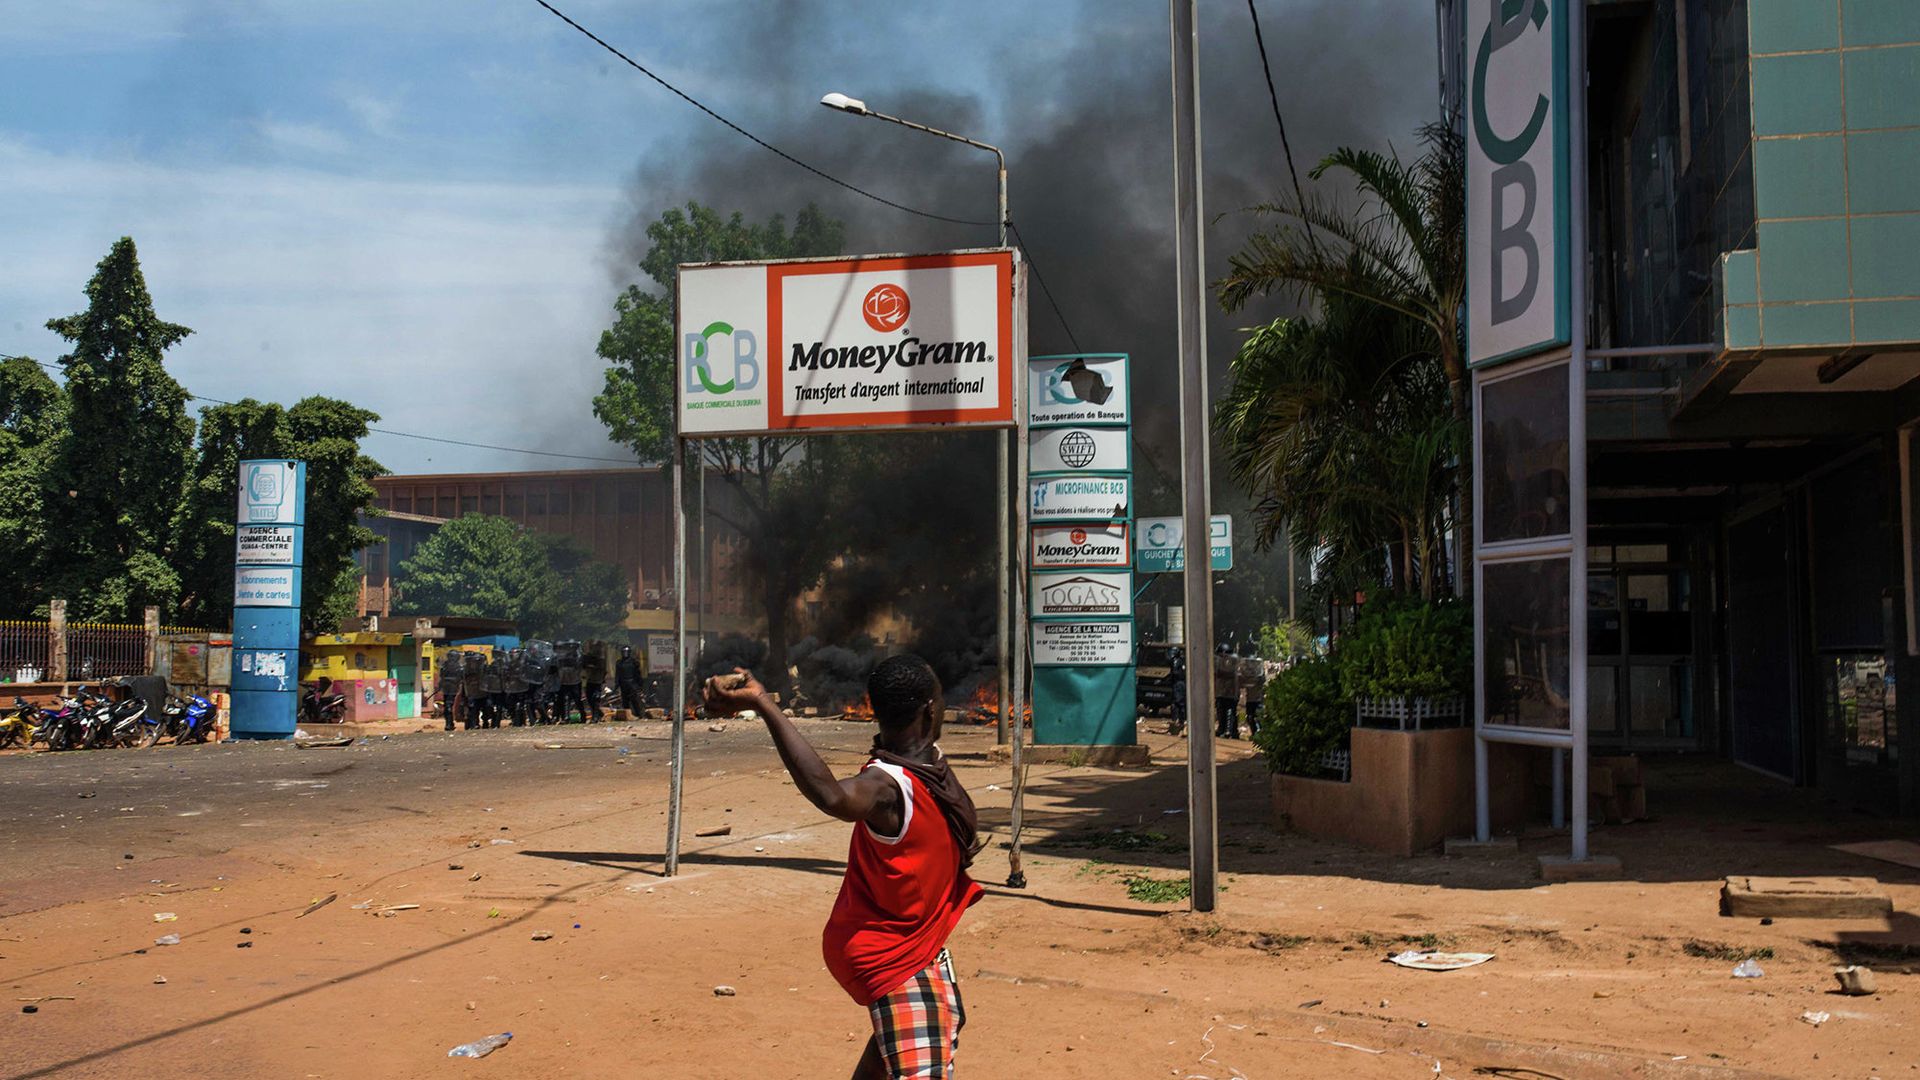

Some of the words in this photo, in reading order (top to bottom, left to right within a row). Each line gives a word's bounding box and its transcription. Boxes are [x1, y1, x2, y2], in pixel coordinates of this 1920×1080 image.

[685, 321, 760, 395] BCB
[789, 337, 987, 373] MoneyGram
[795, 383, 846, 405] Transfert
[851, 380, 900, 402] d'argent
[904, 377, 984, 395] international
[1051, 412, 1085, 421] operation
[1086, 411, 1095, 419] de
[1098, 411, 1124, 420] Banque
[1062, 445, 1093, 454] SWIFT
[1055, 482, 1108, 495] MICROFINANCE
[1110, 482, 1124, 495] BCB
[240, 535, 292, 543] COMMERCIALE
[1037, 544, 1120, 558] MoneyGram
[1144, 550, 1174, 560] GUICHET
[241, 576, 288, 584] Abonnements
[255, 590, 264, 599] de
[265, 591, 290, 600] cartes
